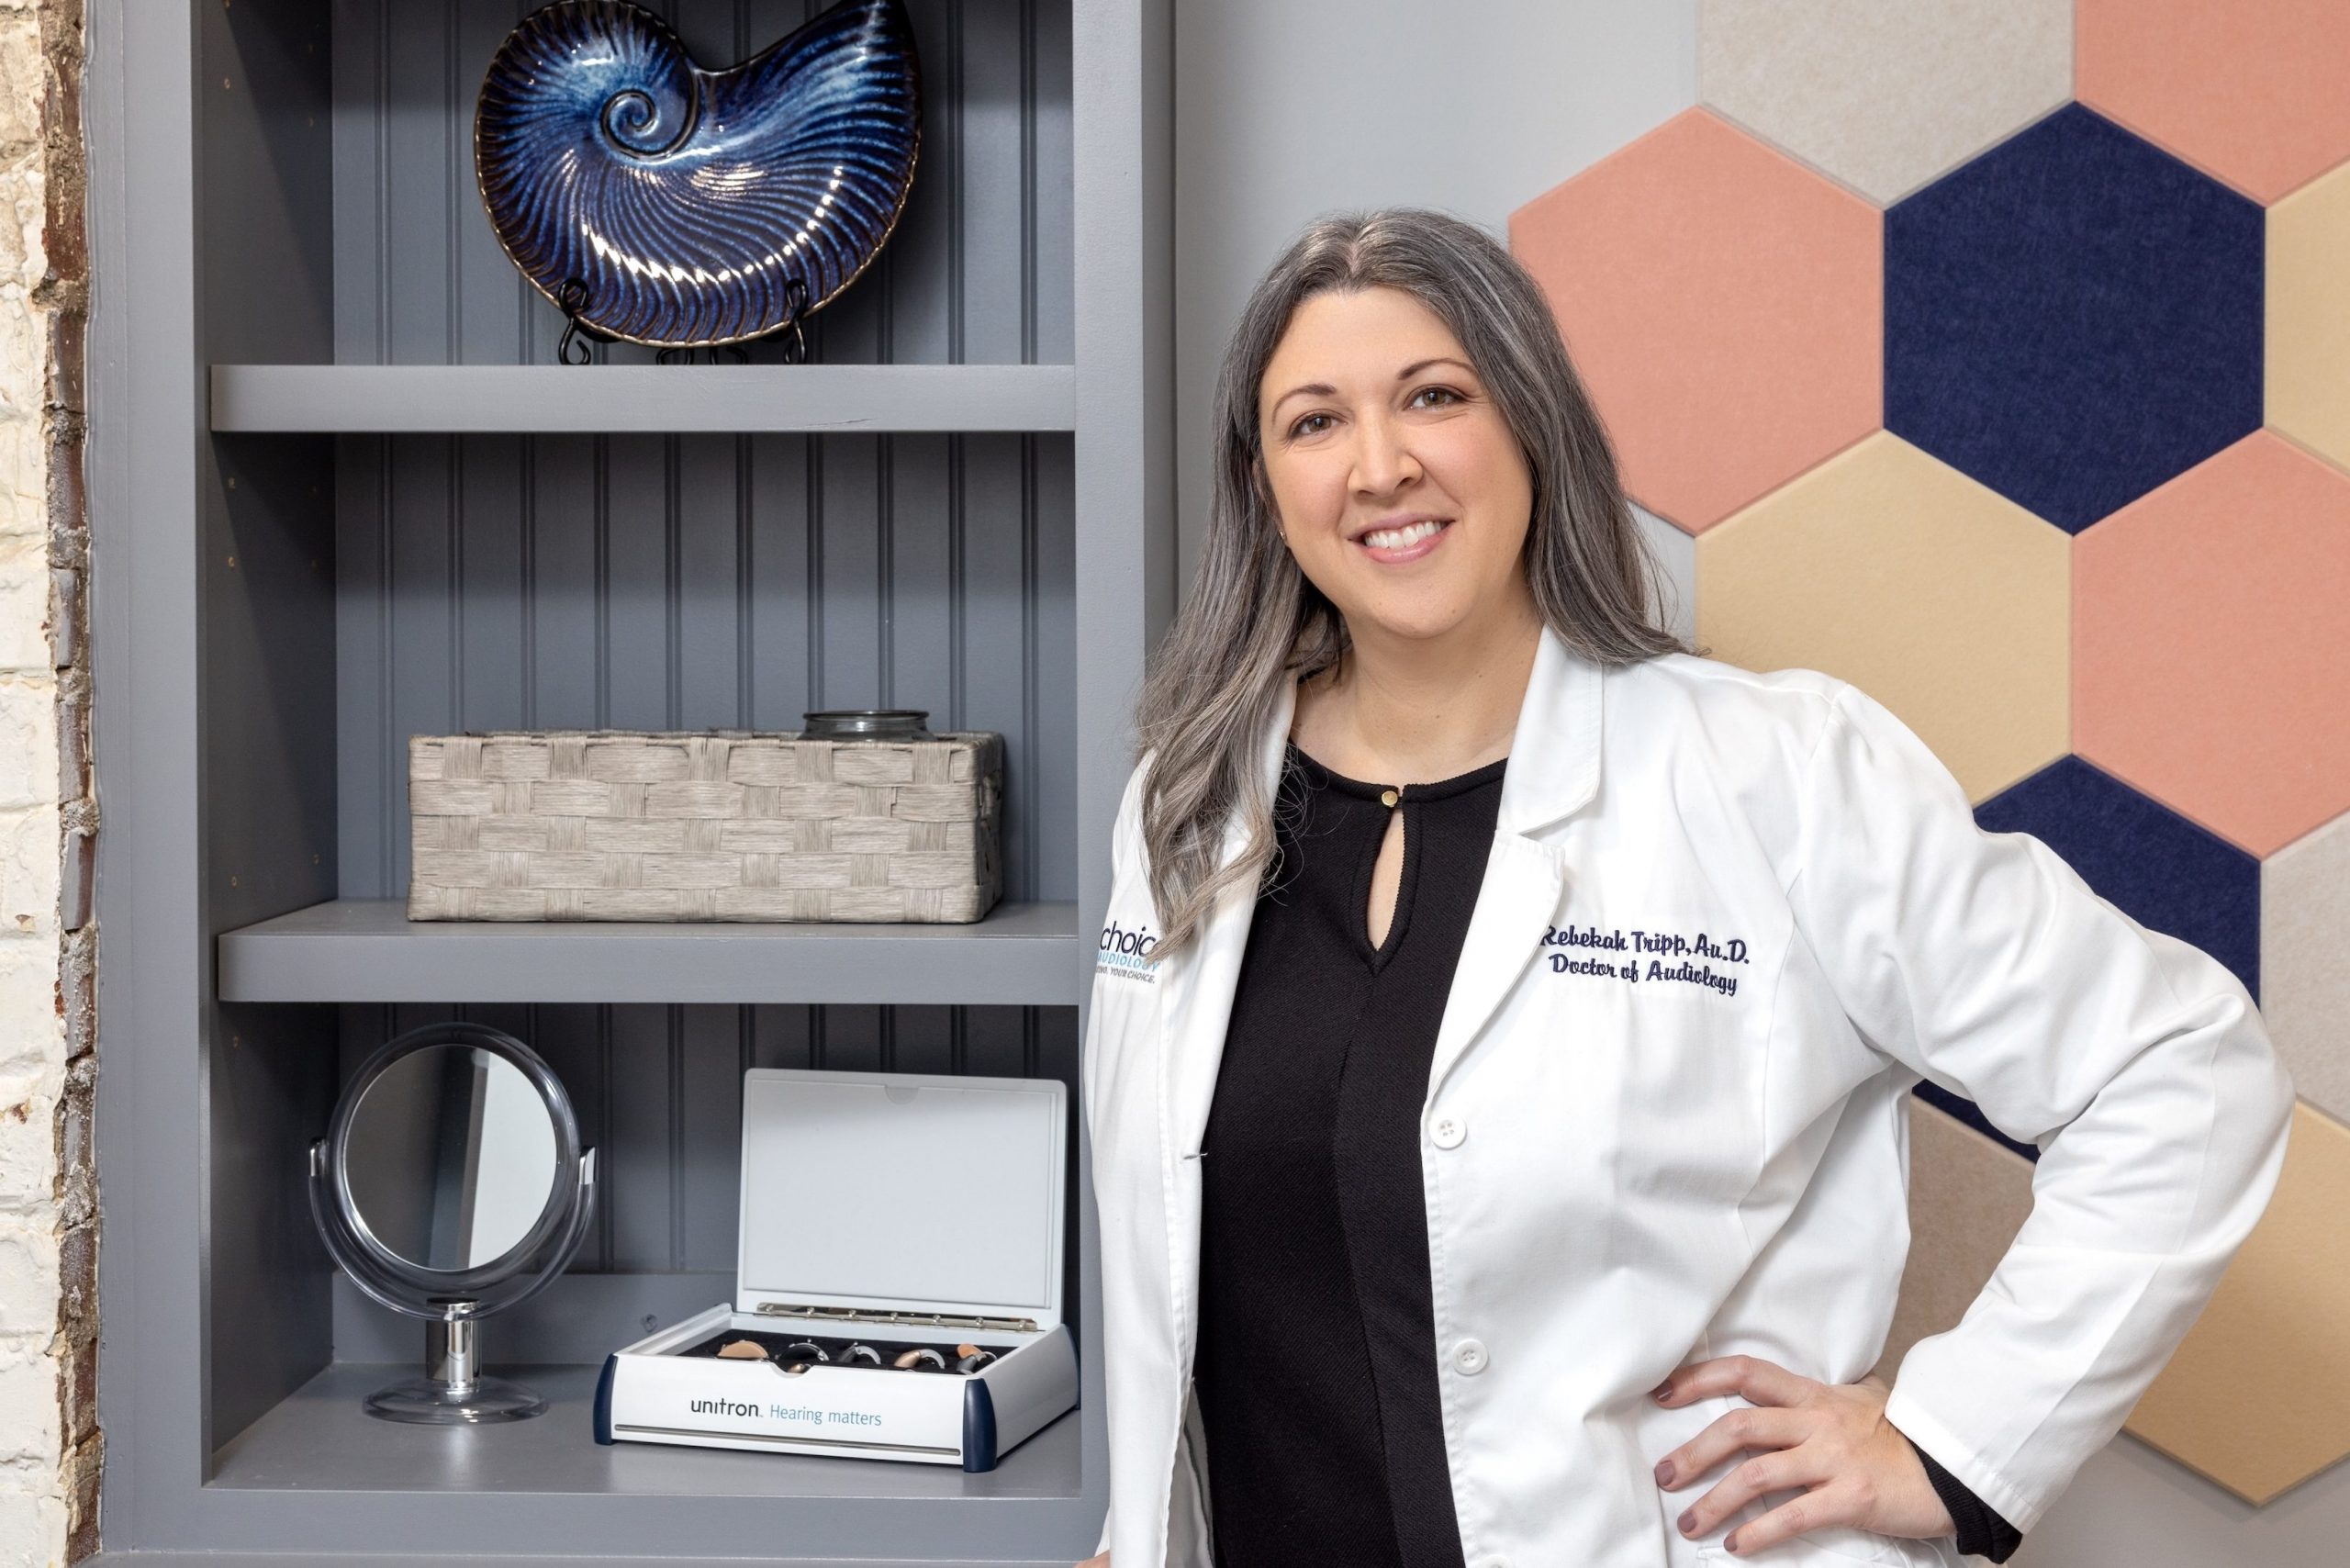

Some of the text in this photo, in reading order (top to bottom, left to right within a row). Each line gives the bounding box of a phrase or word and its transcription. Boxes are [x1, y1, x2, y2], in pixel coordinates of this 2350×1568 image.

[1100, 920, 1157, 958] choic
[1540, 924, 1628, 951] Rebekah
[1548, 953, 1738, 997] Doctor of Audiology
[690, 1397, 882, 1426] unitron Hearing matters
